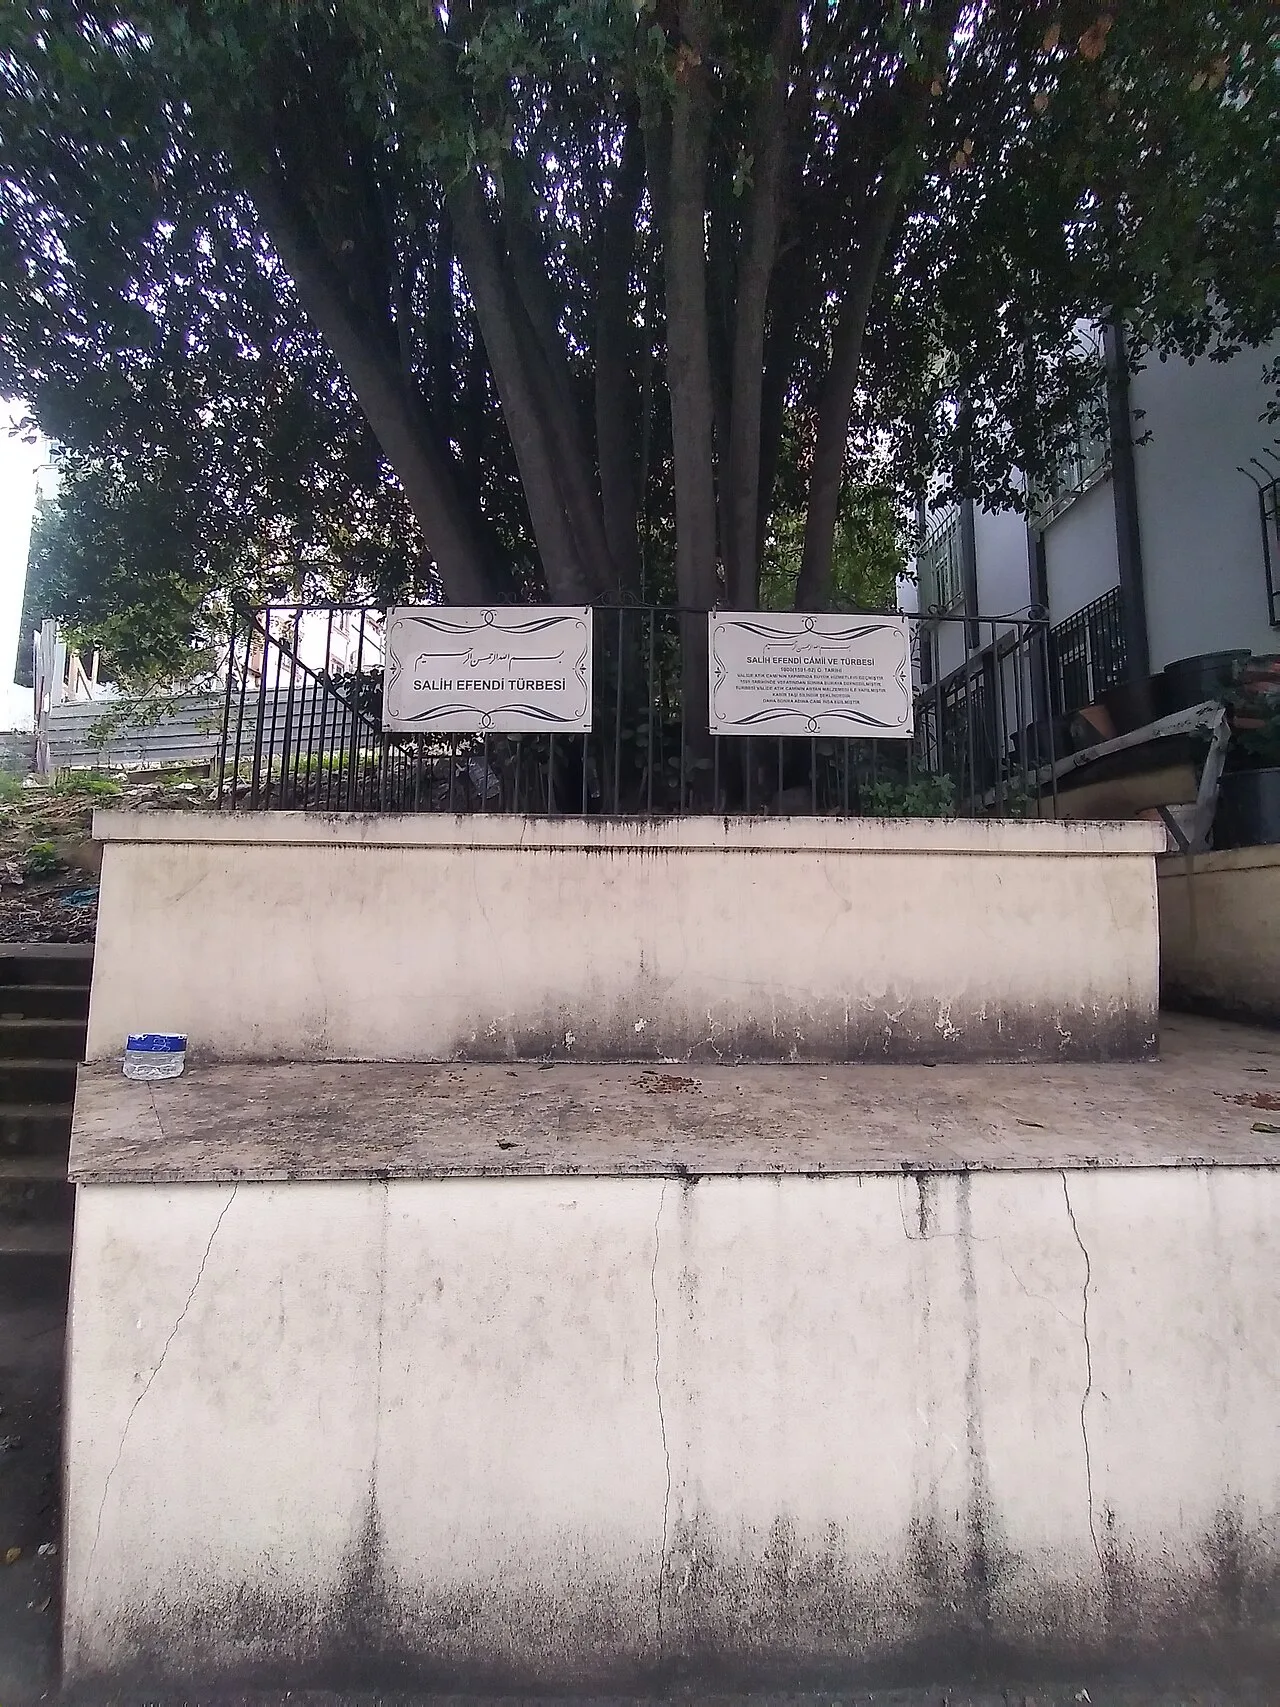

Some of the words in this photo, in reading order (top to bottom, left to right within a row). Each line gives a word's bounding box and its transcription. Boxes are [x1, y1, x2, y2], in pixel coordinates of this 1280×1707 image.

[746, 655, 771, 664] SALİH
[772, 656, 802, 664] EFENDİ
[840, 657, 875, 666] TÜRBESİ
[413, 678, 452, 691] SALİH
[456, 678, 504, 691] EFENDİ
[508, 677, 566, 691] TÜRBESİ
